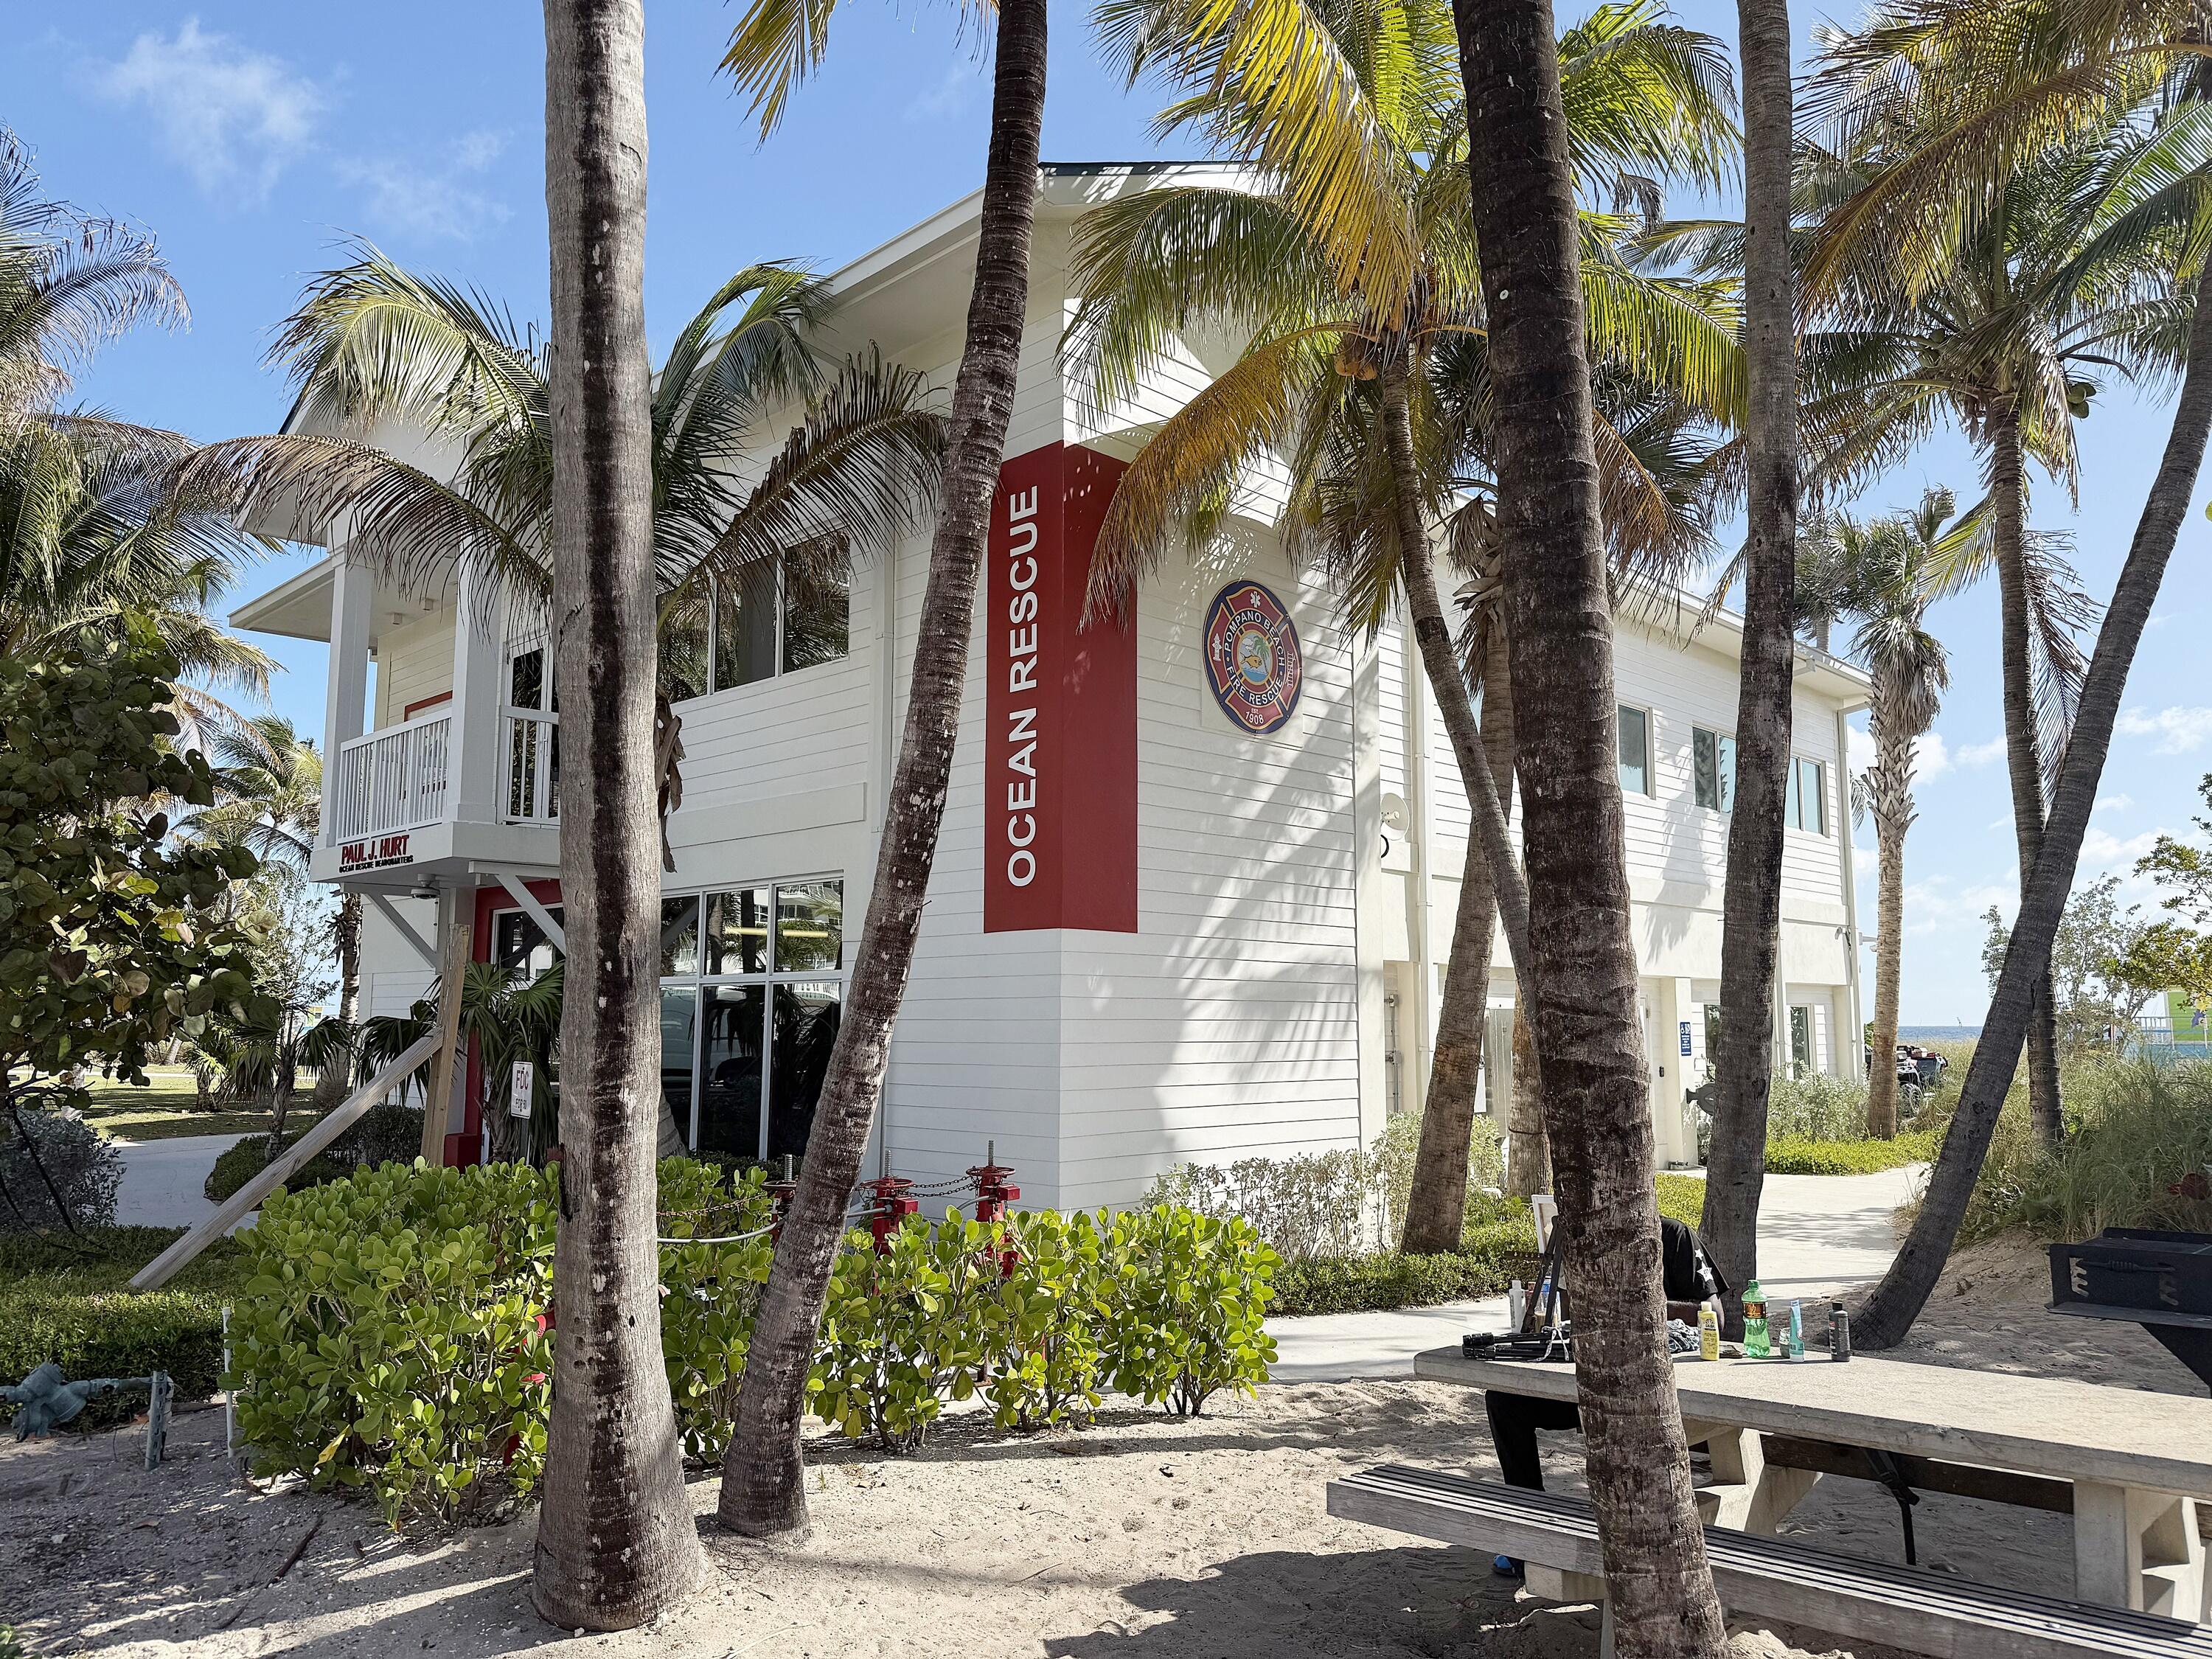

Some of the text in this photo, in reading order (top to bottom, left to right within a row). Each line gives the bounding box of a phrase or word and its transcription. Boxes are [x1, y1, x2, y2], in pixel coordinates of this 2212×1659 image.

[1224, 611, 1285, 667] POMPANO BEACH
[1007, 485, 1039, 888] OCEAN RESCUE
[1227, 667, 1283, 706] FIRE RESCUE
[1246, 712, 1264, 724] 1908
[341, 835, 409, 865] PAUL J. HURT
[355, 861, 374, 871] RESCUE
[375, 855, 413, 867] HEADQUARTERS
[516, 1070, 529, 1090] FDC
